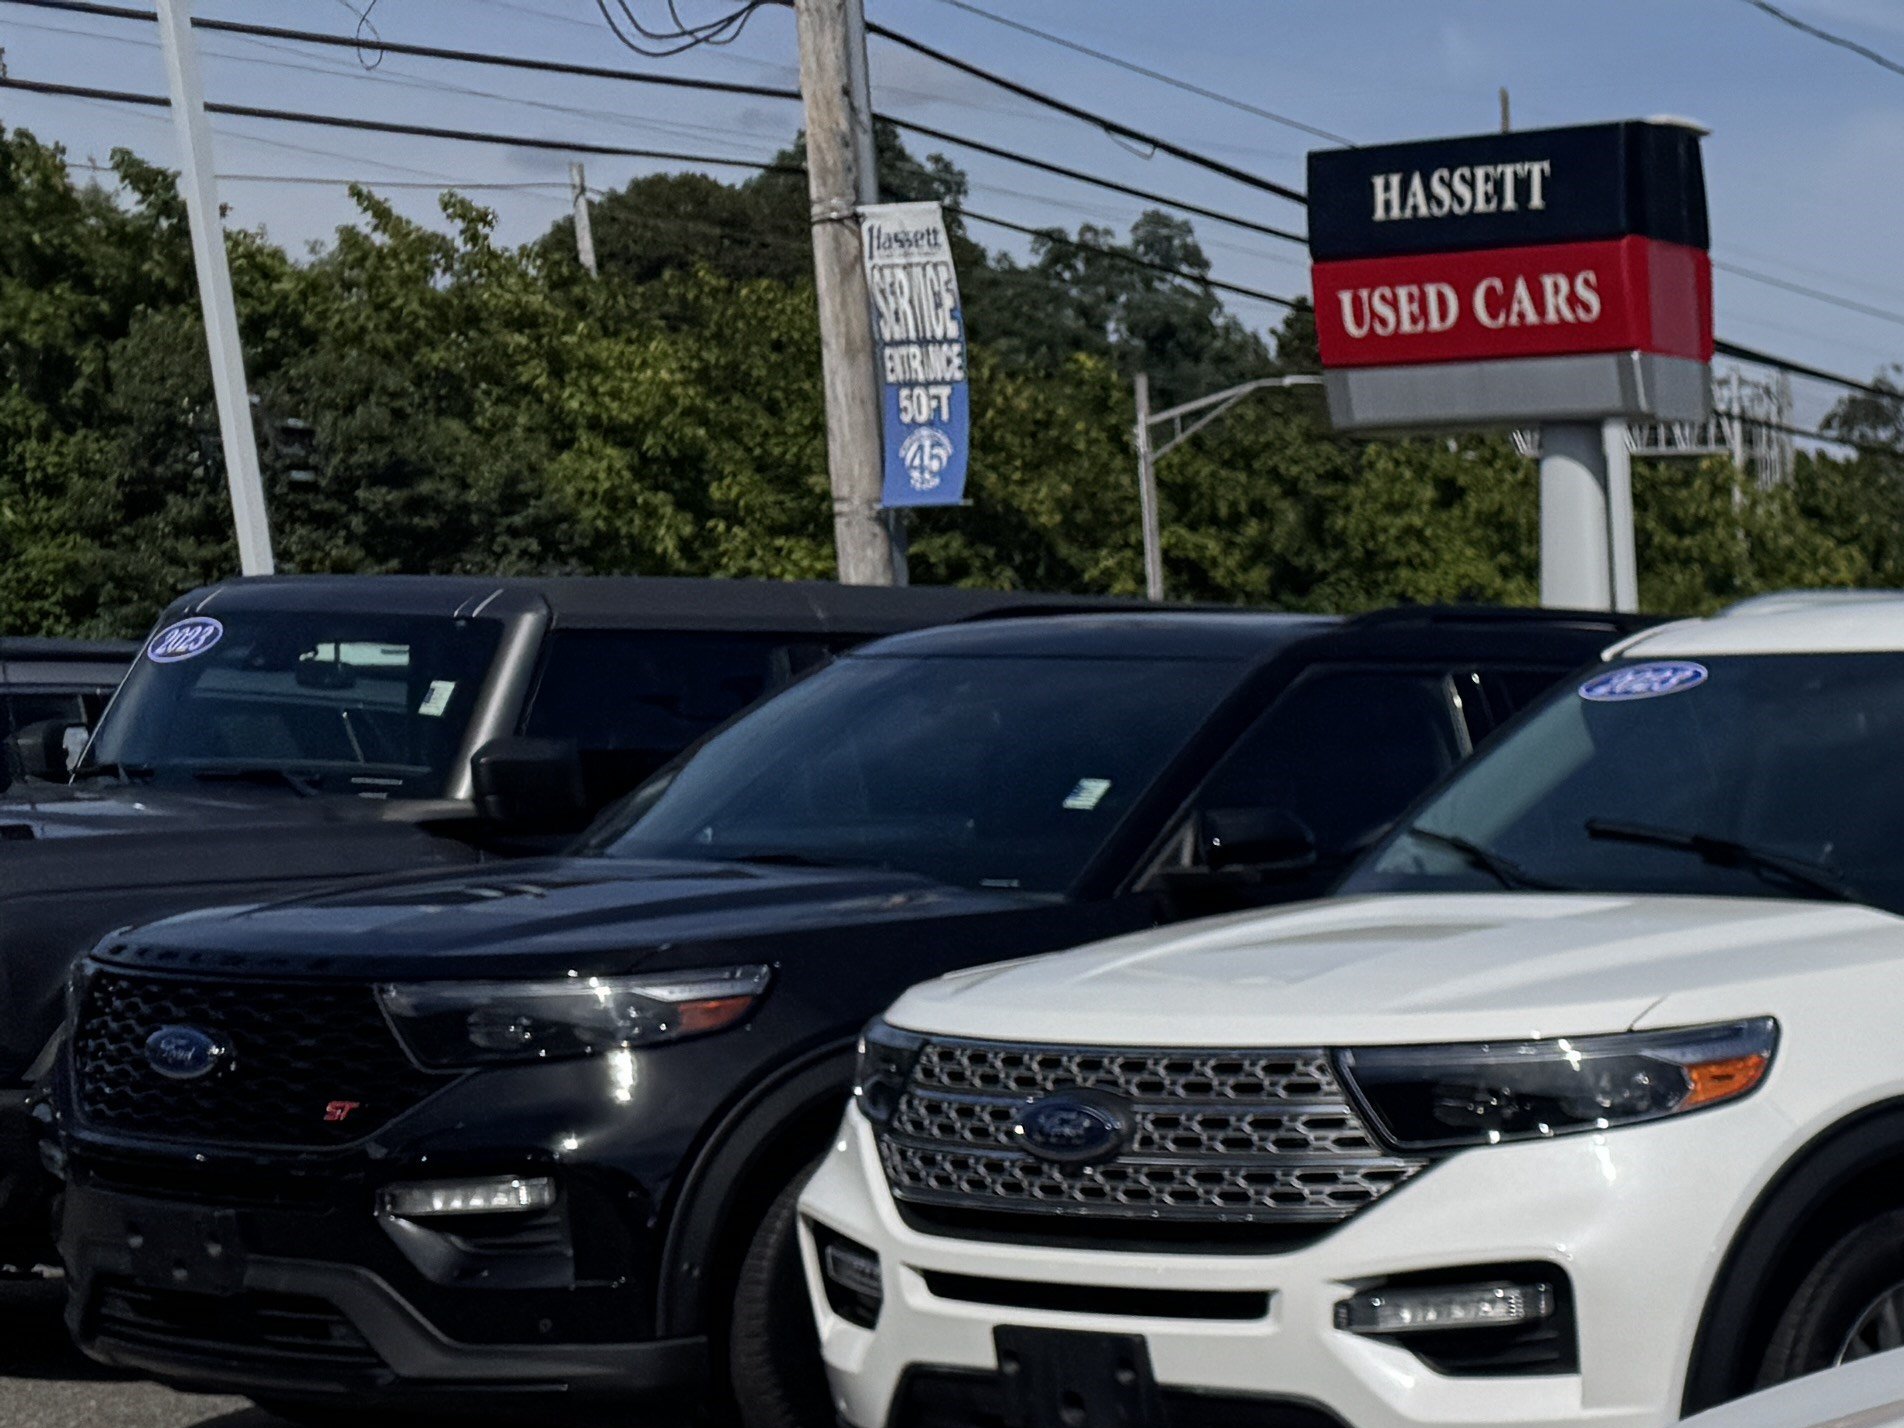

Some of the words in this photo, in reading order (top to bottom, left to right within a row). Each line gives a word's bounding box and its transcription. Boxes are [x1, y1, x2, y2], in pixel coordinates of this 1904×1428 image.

[1371, 160, 1551, 222] HASSETT
[872, 263, 960, 342] SERVICE
[1337, 282, 1459, 339] USED
[1472, 269, 1602, 329] CARS
[883, 343, 964, 383] ENTRANCE
[153, 625, 215, 656] 2023
[322, 1100, 361, 1122] ST
